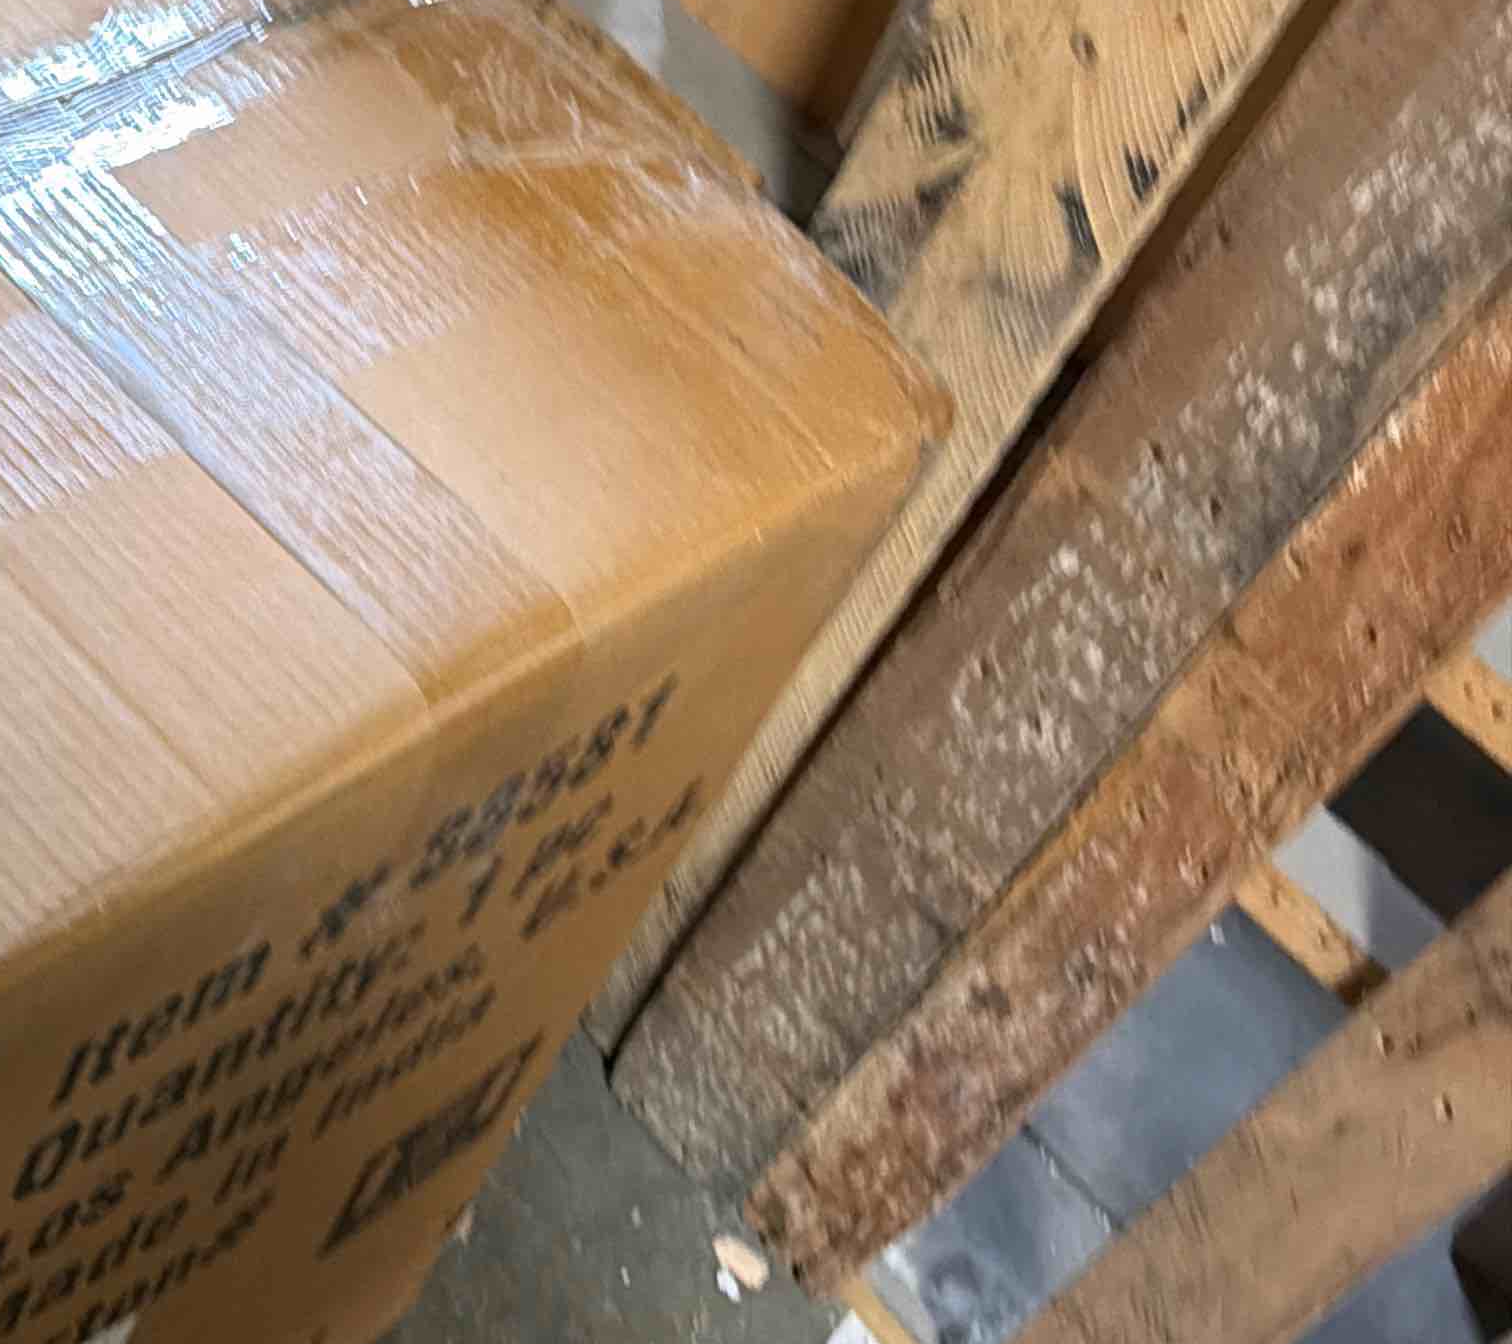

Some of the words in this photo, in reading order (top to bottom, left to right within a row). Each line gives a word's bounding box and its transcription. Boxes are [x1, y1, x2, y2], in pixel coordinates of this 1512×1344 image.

[51, 939, 274, 1104] Item
[300, 856, 392, 958] #
[405, 672, 681, 894] 88581
